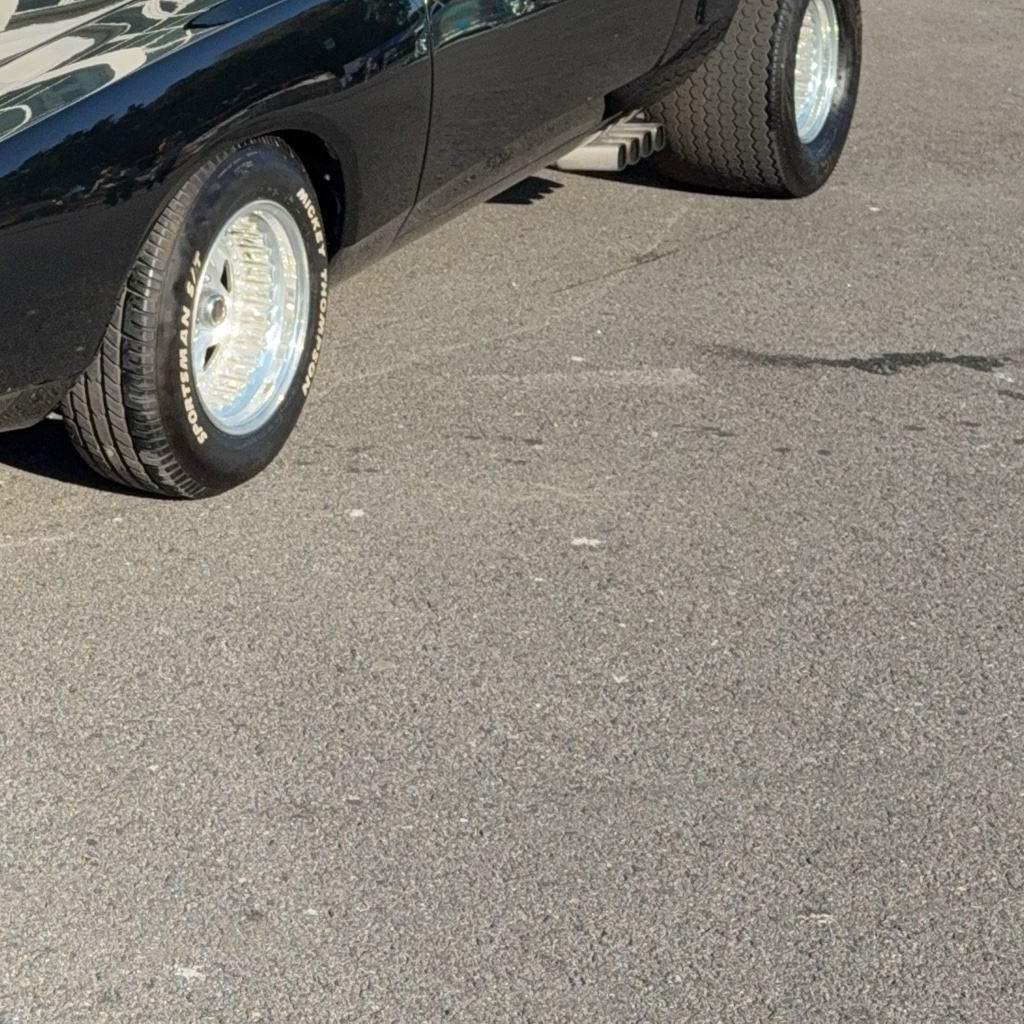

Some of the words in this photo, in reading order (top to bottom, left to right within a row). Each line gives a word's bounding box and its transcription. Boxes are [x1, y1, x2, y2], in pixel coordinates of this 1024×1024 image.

[296, 187, 327, 257] MICKEY
[185, 250, 203, 302] S/T
[178, 305, 208, 444] SPORTSMAN
[301, 267, 329, 397] THOMPSON
